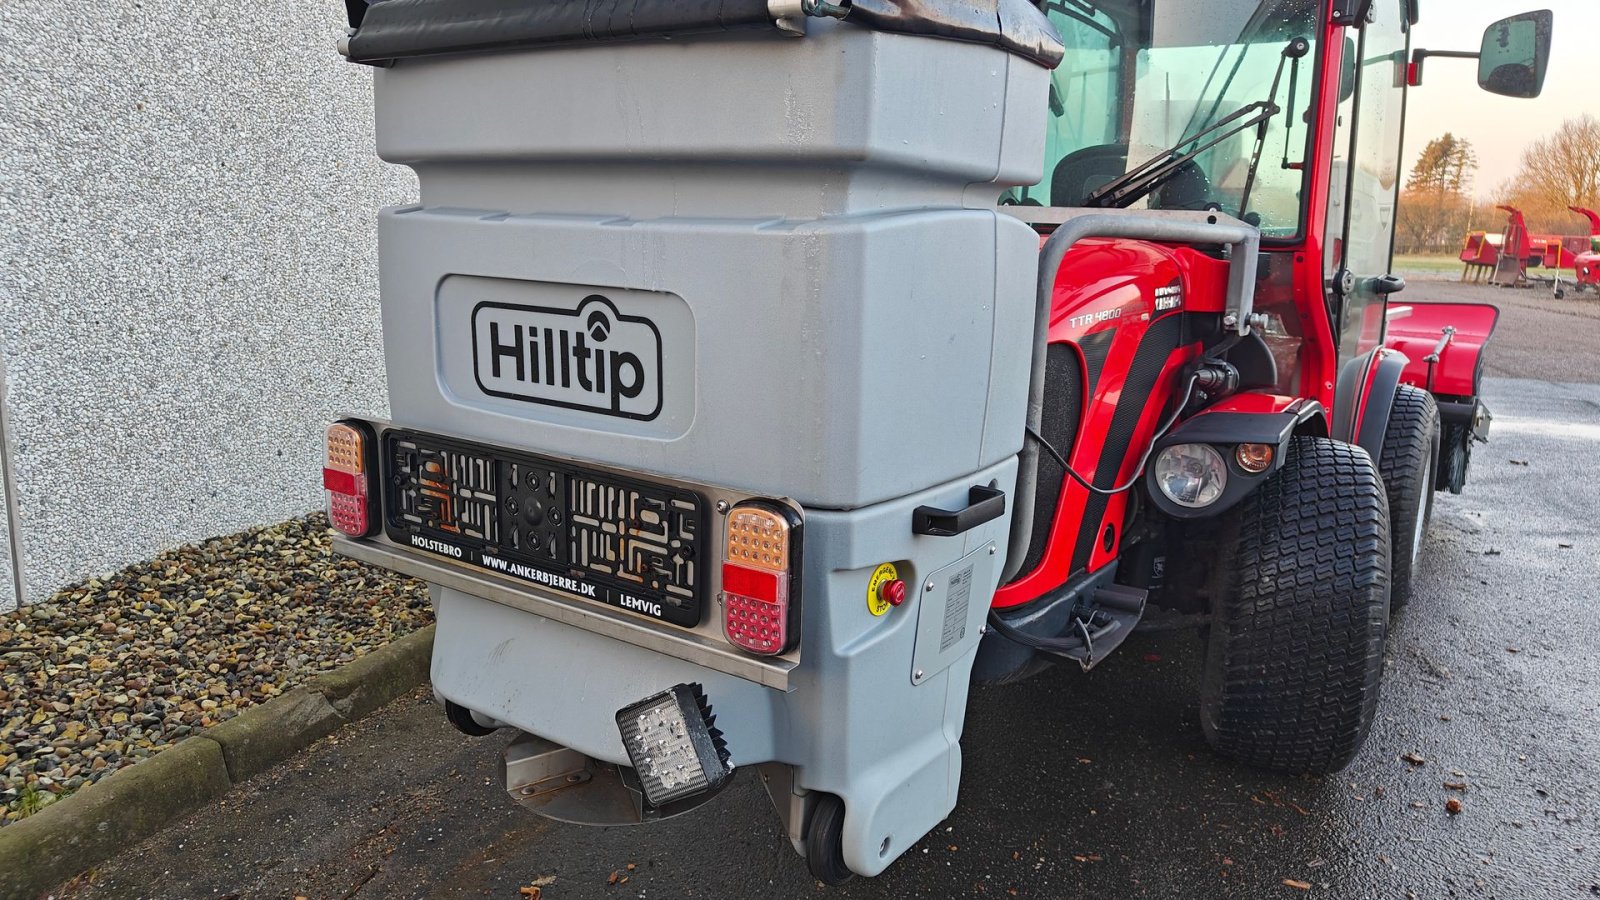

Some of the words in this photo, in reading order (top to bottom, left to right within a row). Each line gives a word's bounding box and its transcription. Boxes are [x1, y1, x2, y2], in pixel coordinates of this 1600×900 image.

[1070, 314, 1093, 329] TTR
[1094, 308, 1121, 322] 4800
[490, 310, 645, 413] Hilltip
[411, 535, 462, 558] HOLSTEBRO
[482, 555, 596, 597] WWW.ANKERBJERRE.DK
[620, 594, 662, 617] LEMVIG
